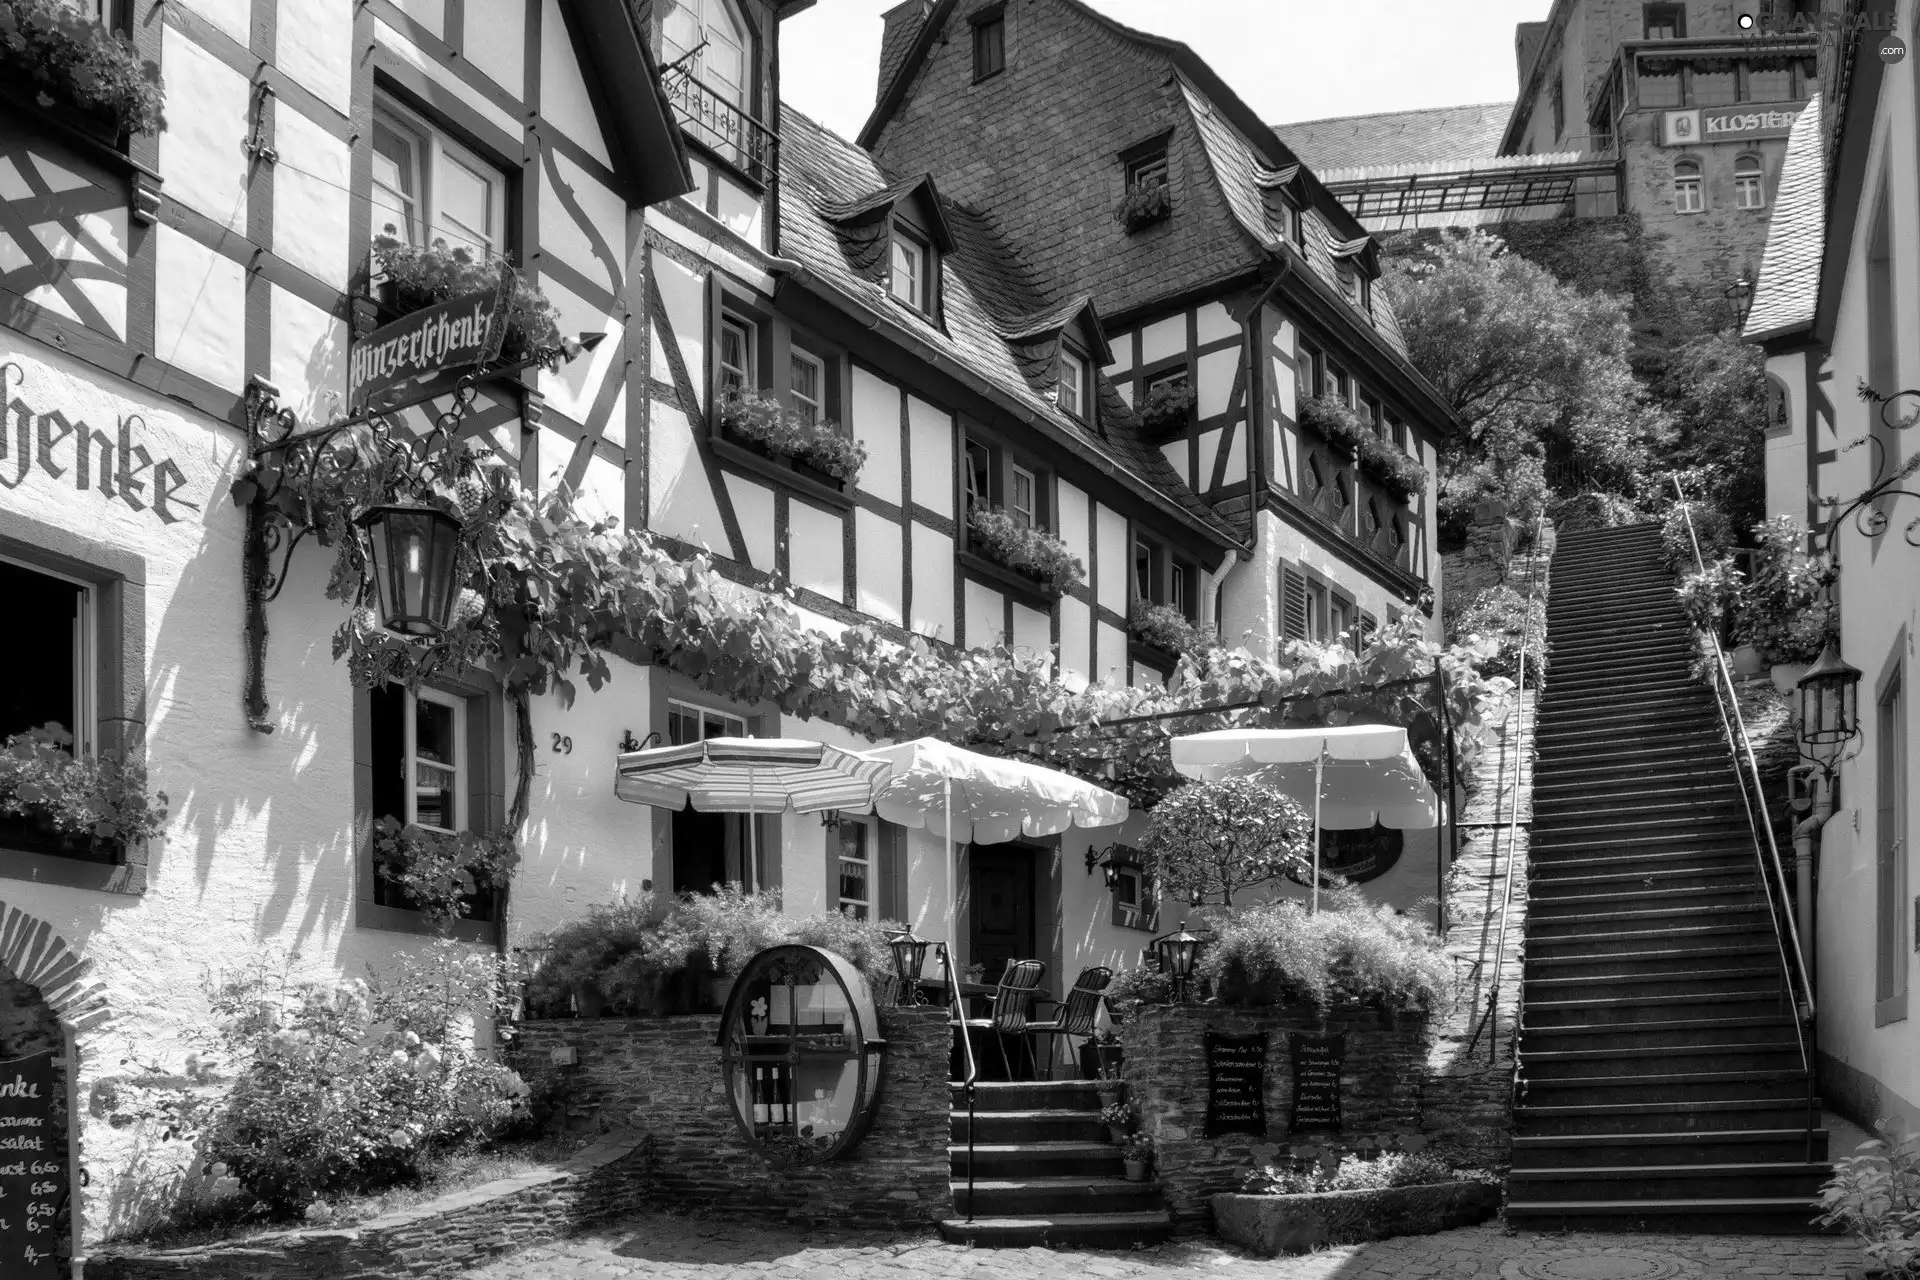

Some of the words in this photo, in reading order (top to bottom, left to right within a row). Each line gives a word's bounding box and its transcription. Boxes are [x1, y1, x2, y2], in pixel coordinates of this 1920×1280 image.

[1706, 109, 1802, 133] KLOSTER
[550, 731, 573, 755] 29
[30, 1160, 60, 1175] 6,50
[30, 1181, 58, 1195] 6,50
[26, 1201, 56, 1216] 6,50
